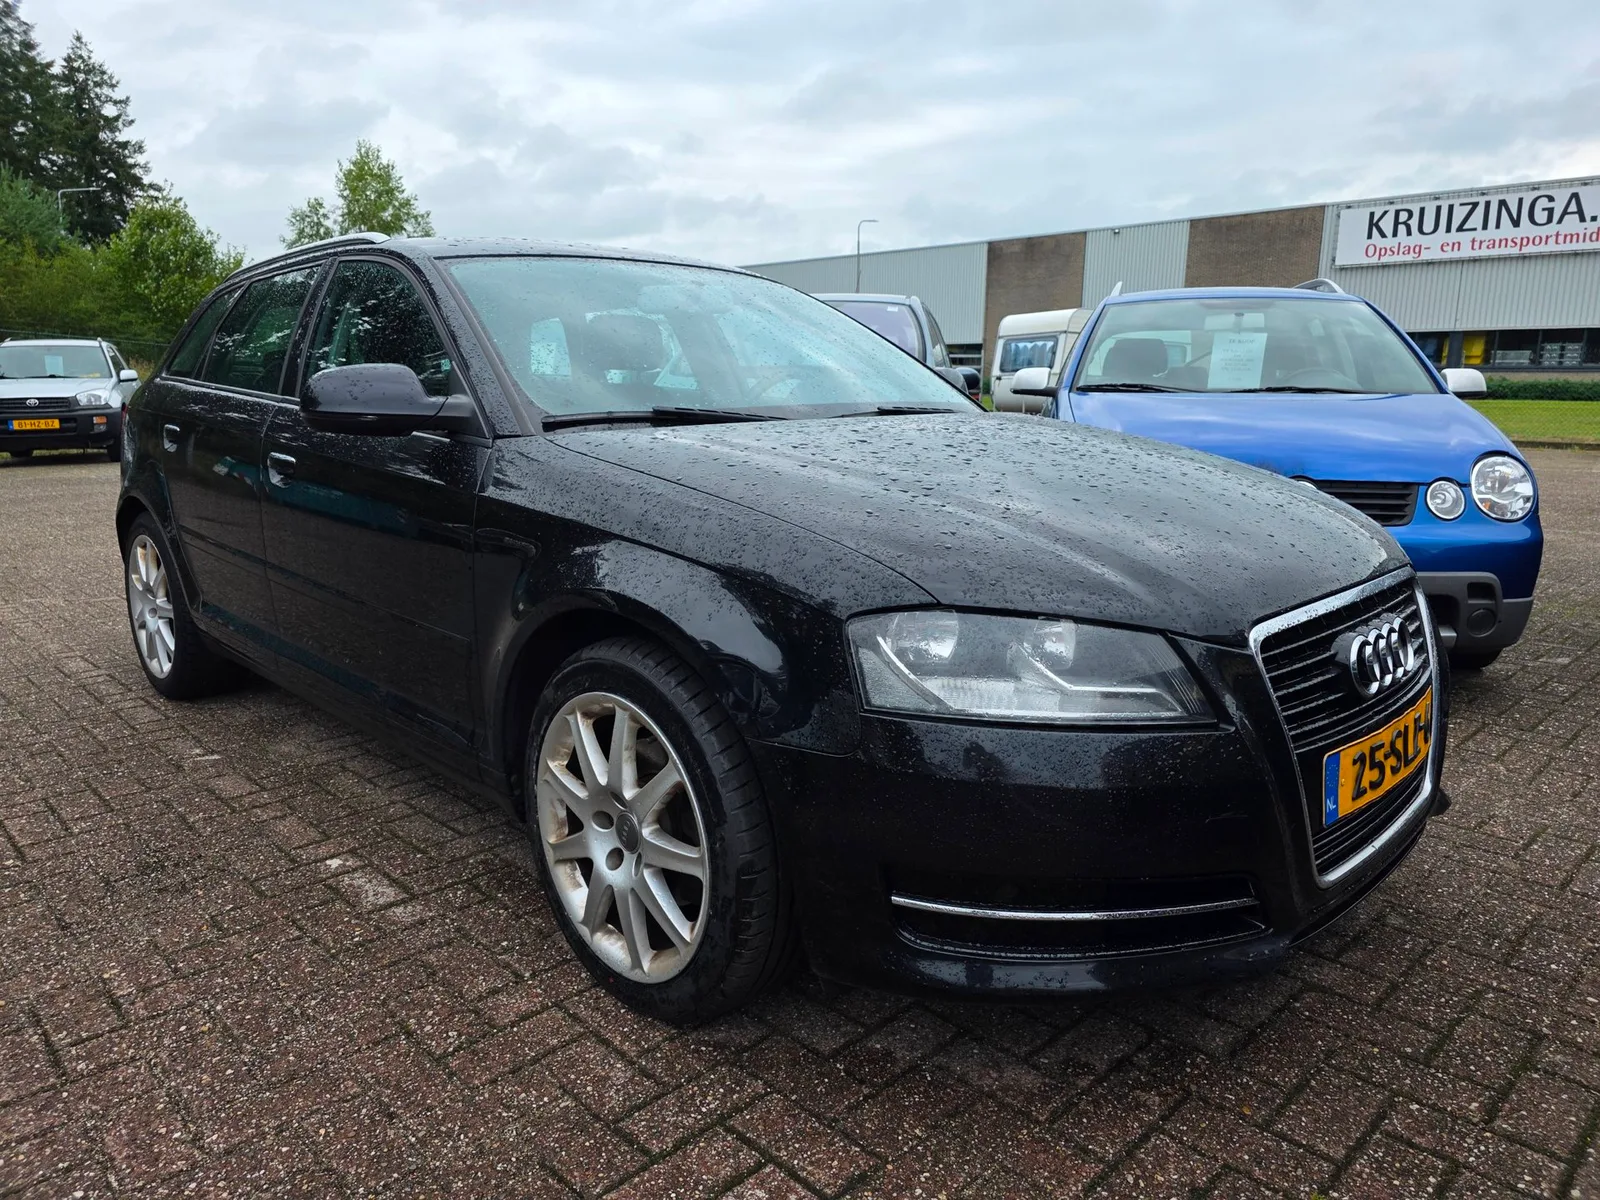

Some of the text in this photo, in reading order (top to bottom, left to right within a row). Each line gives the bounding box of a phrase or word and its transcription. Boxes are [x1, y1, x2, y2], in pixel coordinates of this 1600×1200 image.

[1366, 192, 1598, 240] KRUIZINGA.
[1364, 226, 1600, 261] Opslag- en transportmid
[1326, 796, 1337, 813] NL
